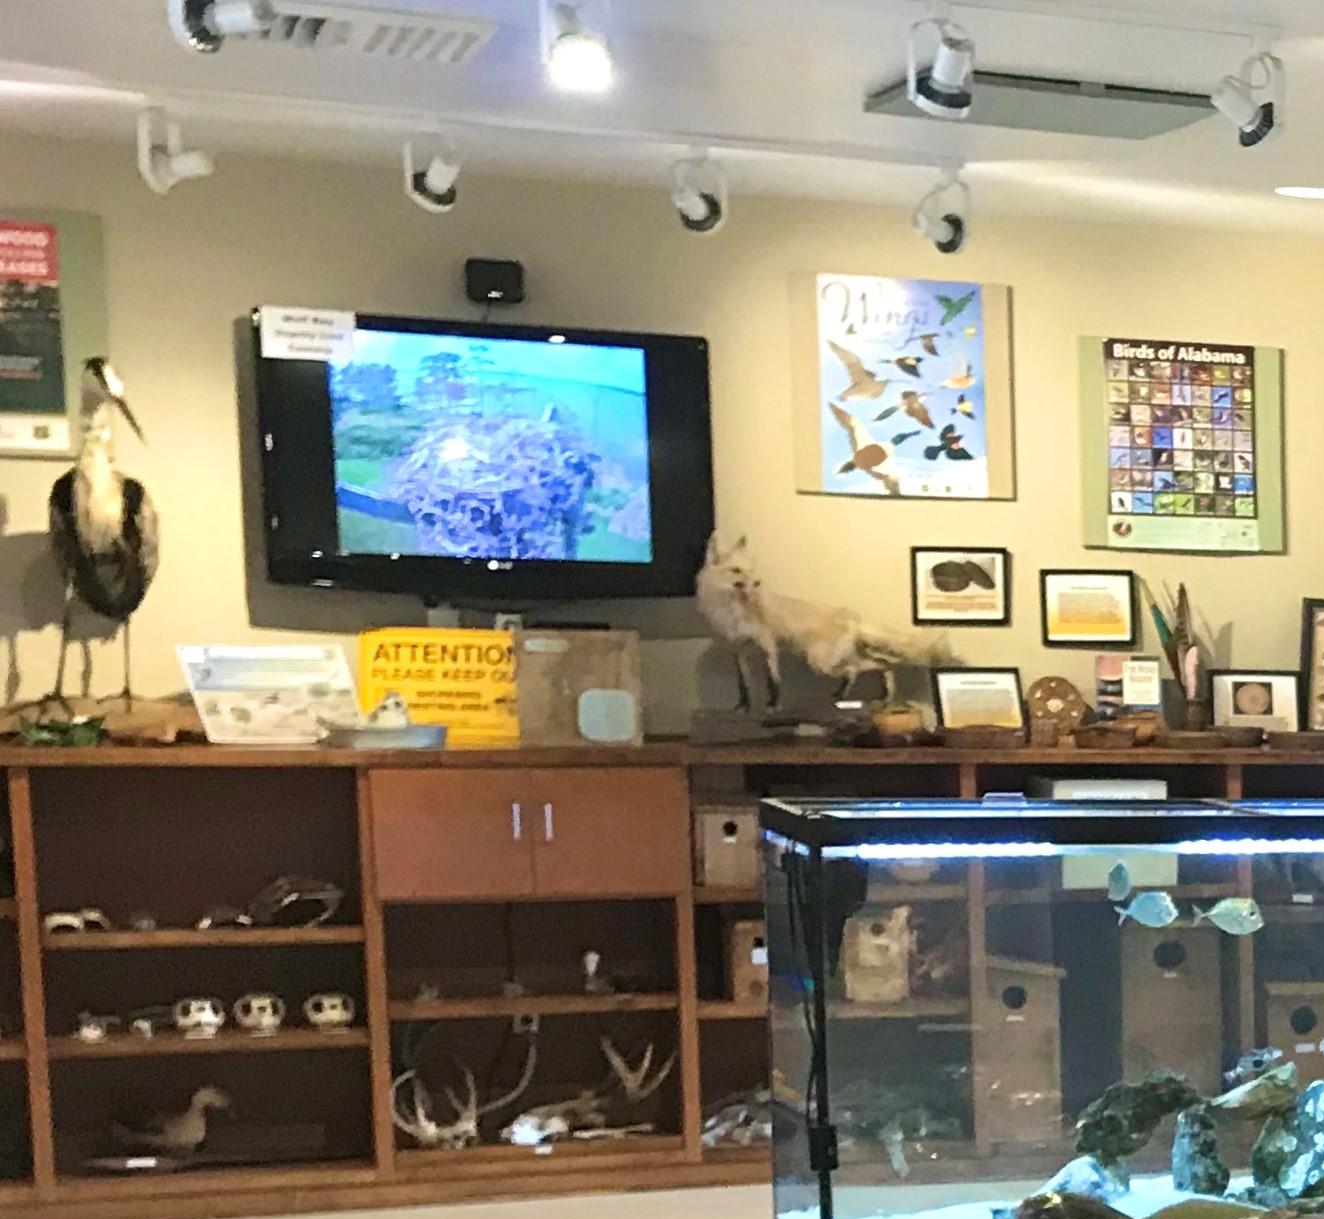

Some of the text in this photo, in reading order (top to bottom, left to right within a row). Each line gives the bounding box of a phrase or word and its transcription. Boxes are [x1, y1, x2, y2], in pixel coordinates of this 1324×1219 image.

[1113, 343, 1246, 364] Birds of Alabama
[372, 668, 436, 681] PLEASE
[441, 668, 486, 682] KEEP
